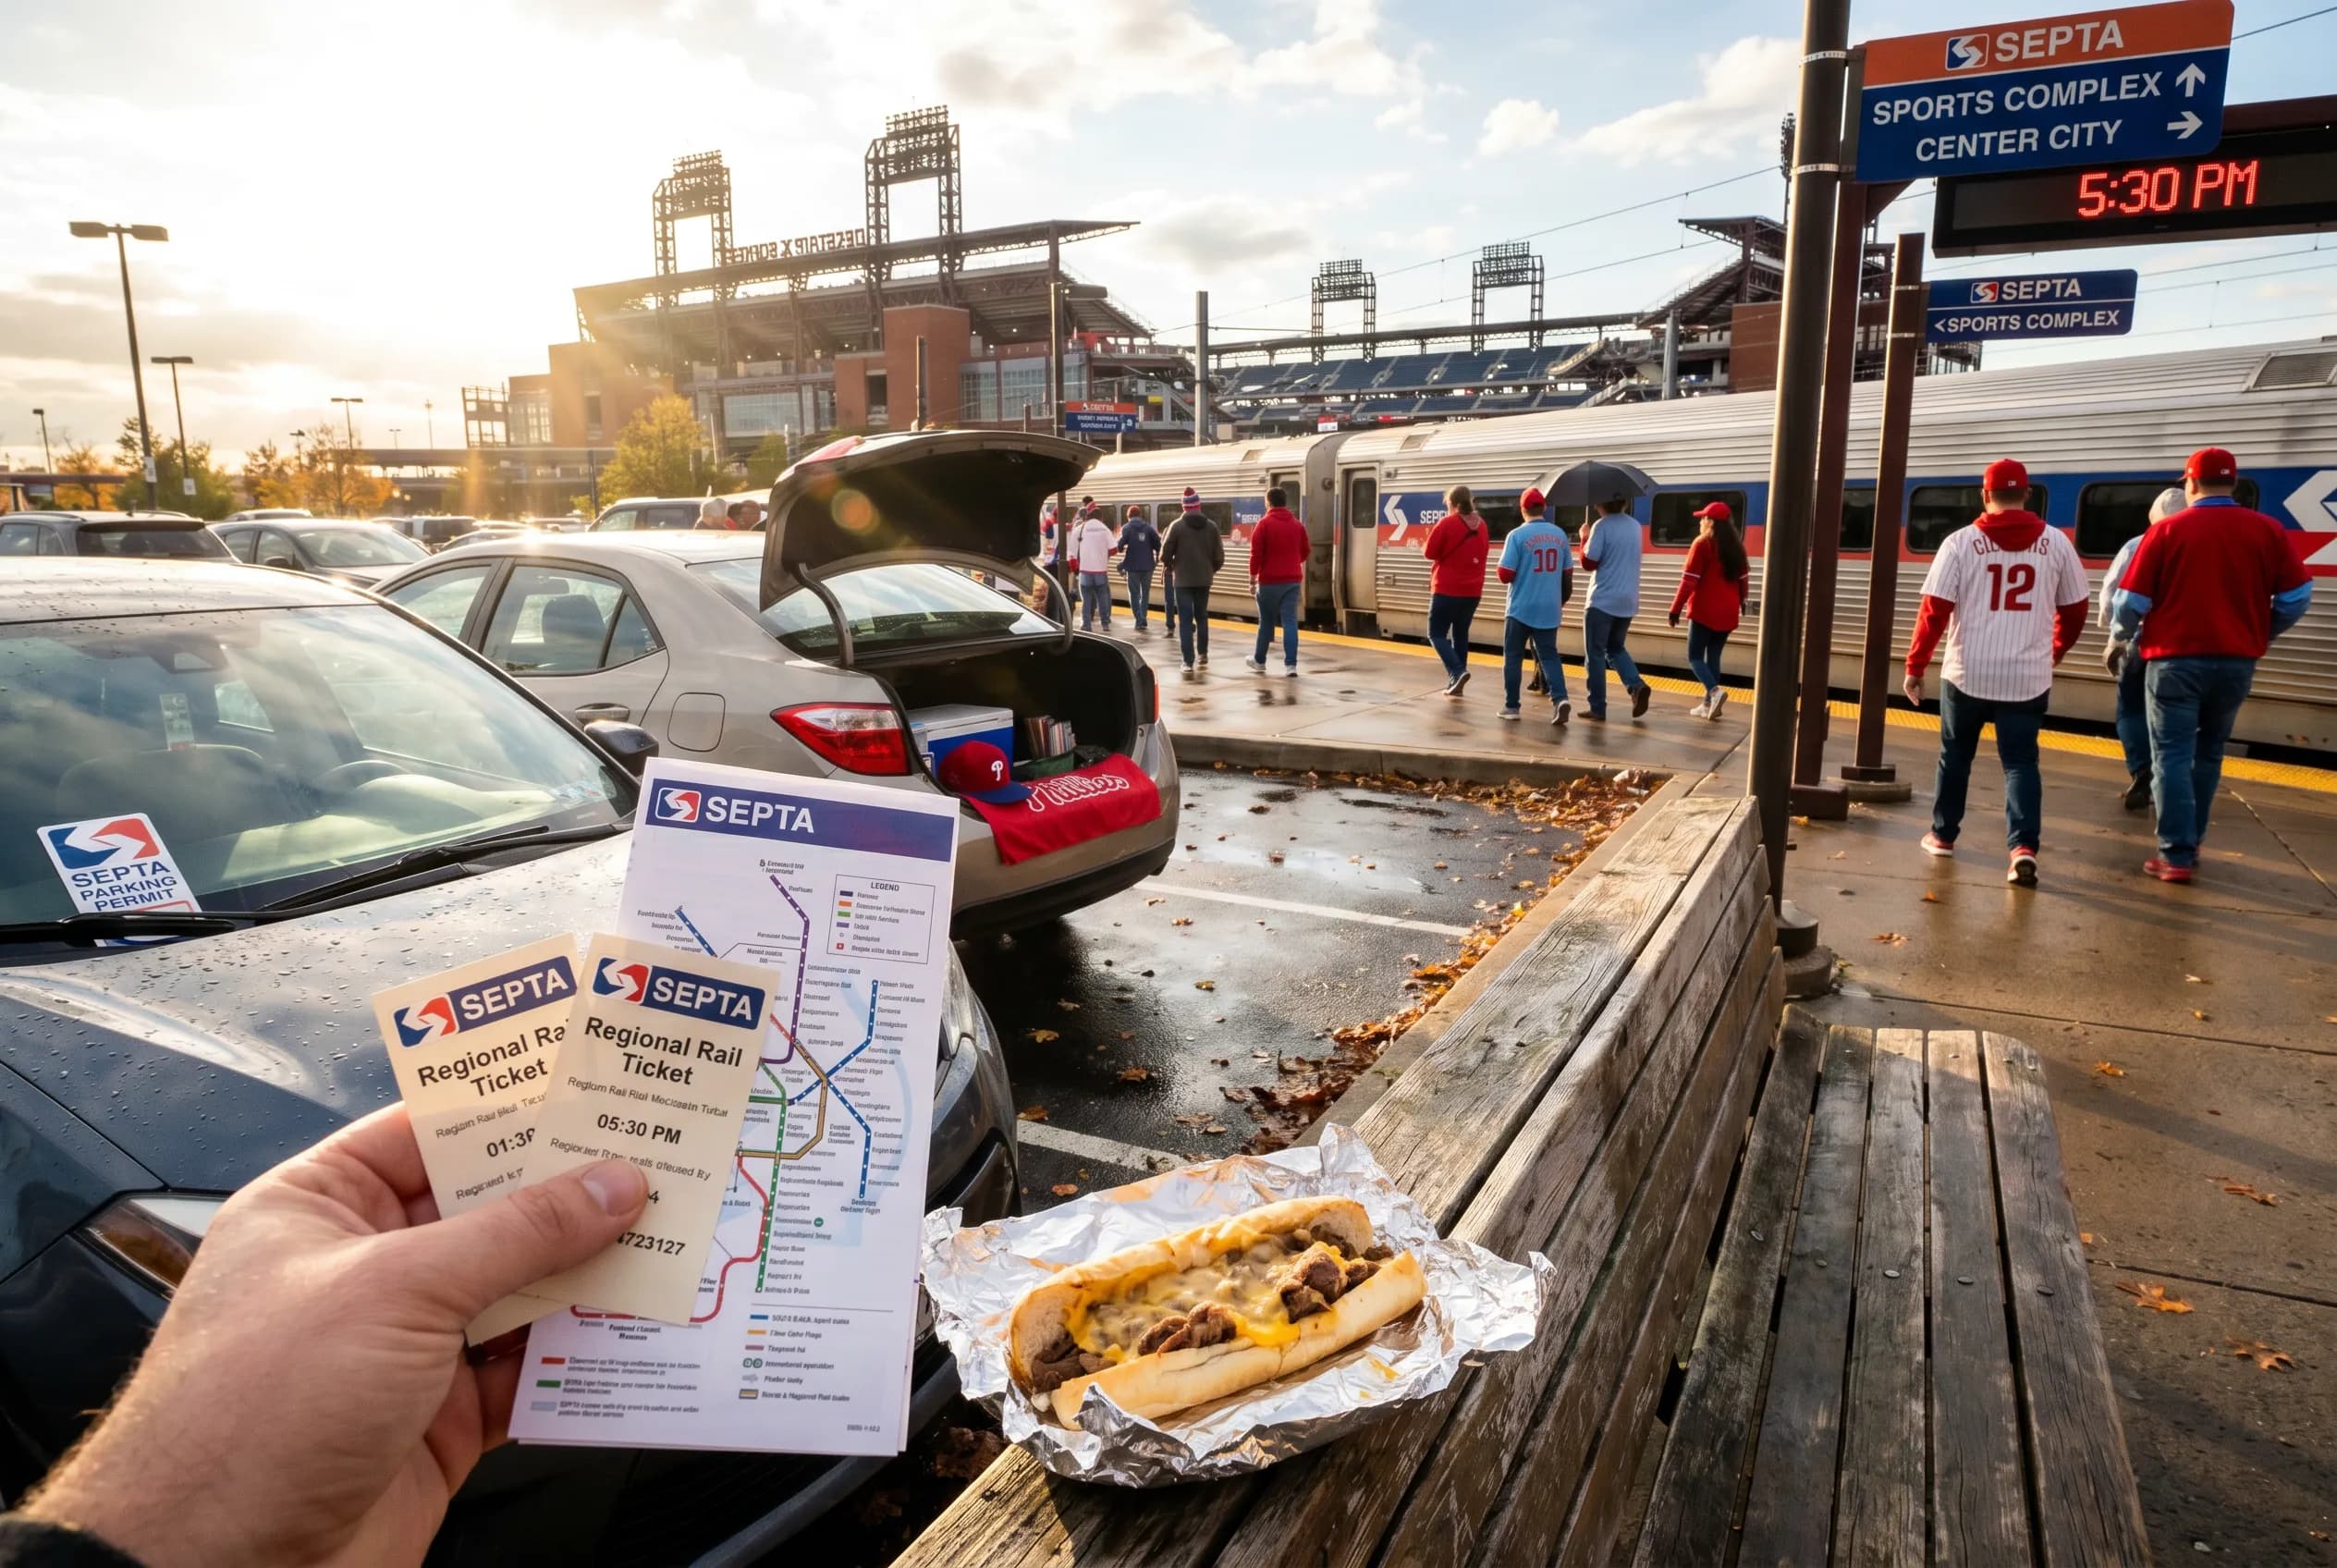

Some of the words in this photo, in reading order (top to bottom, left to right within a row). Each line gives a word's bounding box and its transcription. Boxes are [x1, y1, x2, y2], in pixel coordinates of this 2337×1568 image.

[1994, 19, 2124, 62] SEPTA
[1872, 90, 1994, 125] SPORTS
[2004, 71, 2163, 112] COMPLEX
[1915, 129, 2038, 162] CENTER
[2048, 119, 2123, 149] CITY
[2077, 166, 2182, 218] 5:30
[2193, 159, 2259, 209] PM
[2001, 278, 2083, 300] SEPTA
[2025, 310, 2120, 330] COMPLEX
[1533, 548, 1559, 574] 10
[1986, 563, 2037, 611] 12
[990, 760, 1005, 782] P
[705, 796, 815, 833] SEPTA
[71, 861, 171, 888] SEPTA
[80, 876, 177, 901] PARKING
[95, 888, 175, 912] PERMIT
[460, 967, 569, 1022] SEPTA
[653, 975, 753, 1022] SEPTA
[417, 1035, 531, 1088] Regional
[534, 1018, 569, 1047] Ra
[584, 1016, 691, 1059] Regional
[695, 1041, 744, 1068] Rail
[470, 1057, 548, 1098] Ticket
[621, 1051, 695, 1086] Ticket
[597, 1114, 648, 1137] 05:30
[652, 1124, 682, 1145] PM
